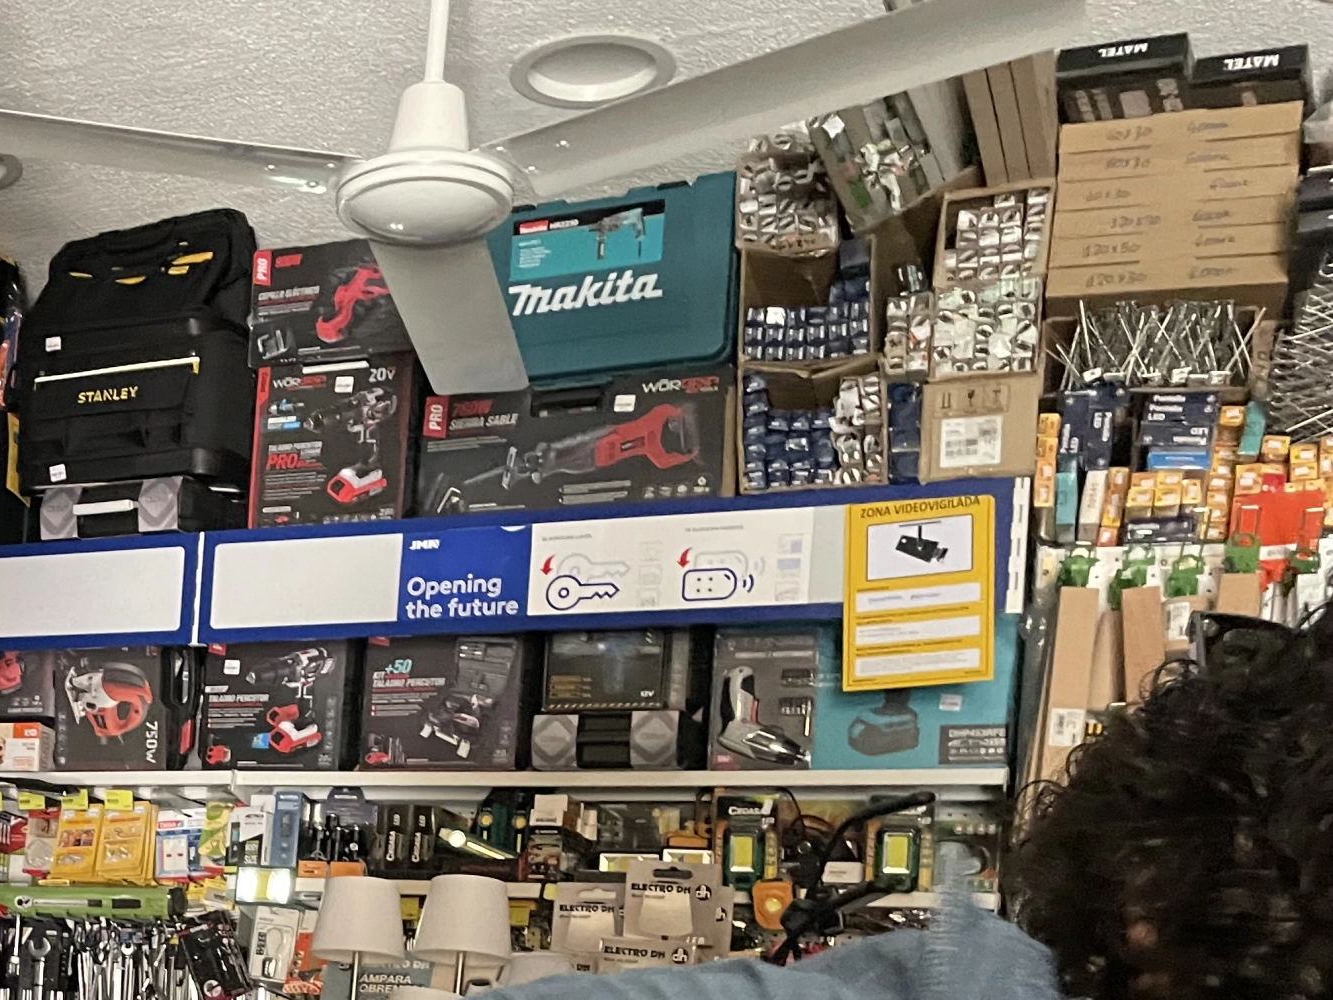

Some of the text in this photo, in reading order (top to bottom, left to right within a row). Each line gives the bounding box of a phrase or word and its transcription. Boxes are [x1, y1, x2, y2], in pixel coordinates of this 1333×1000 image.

[1098, 42, 1148, 58] MATEL
[1222, 53, 1280, 71] MATEL
[256, 257, 268, 280] PRO
[77, 386, 139, 404] STANLEY
[428, 404, 443, 431] PRO
[485, 413, 518, 427] SABLE
[265, 454, 299, 471] PRO
[860, 496, 981, 519] ZONA VIDEOVIGILADA
[407, 574, 502, 601] Opening
[405, 597, 519, 619] the future
[145, 720, 159, 764] 750W
[631, 883, 692, 894] ELECTRO DH
[559, 904, 600, 914] ELECTRO
[604, 946, 666, 960] ELECTRO DH
[359, 973, 412, 985] AMPARA
